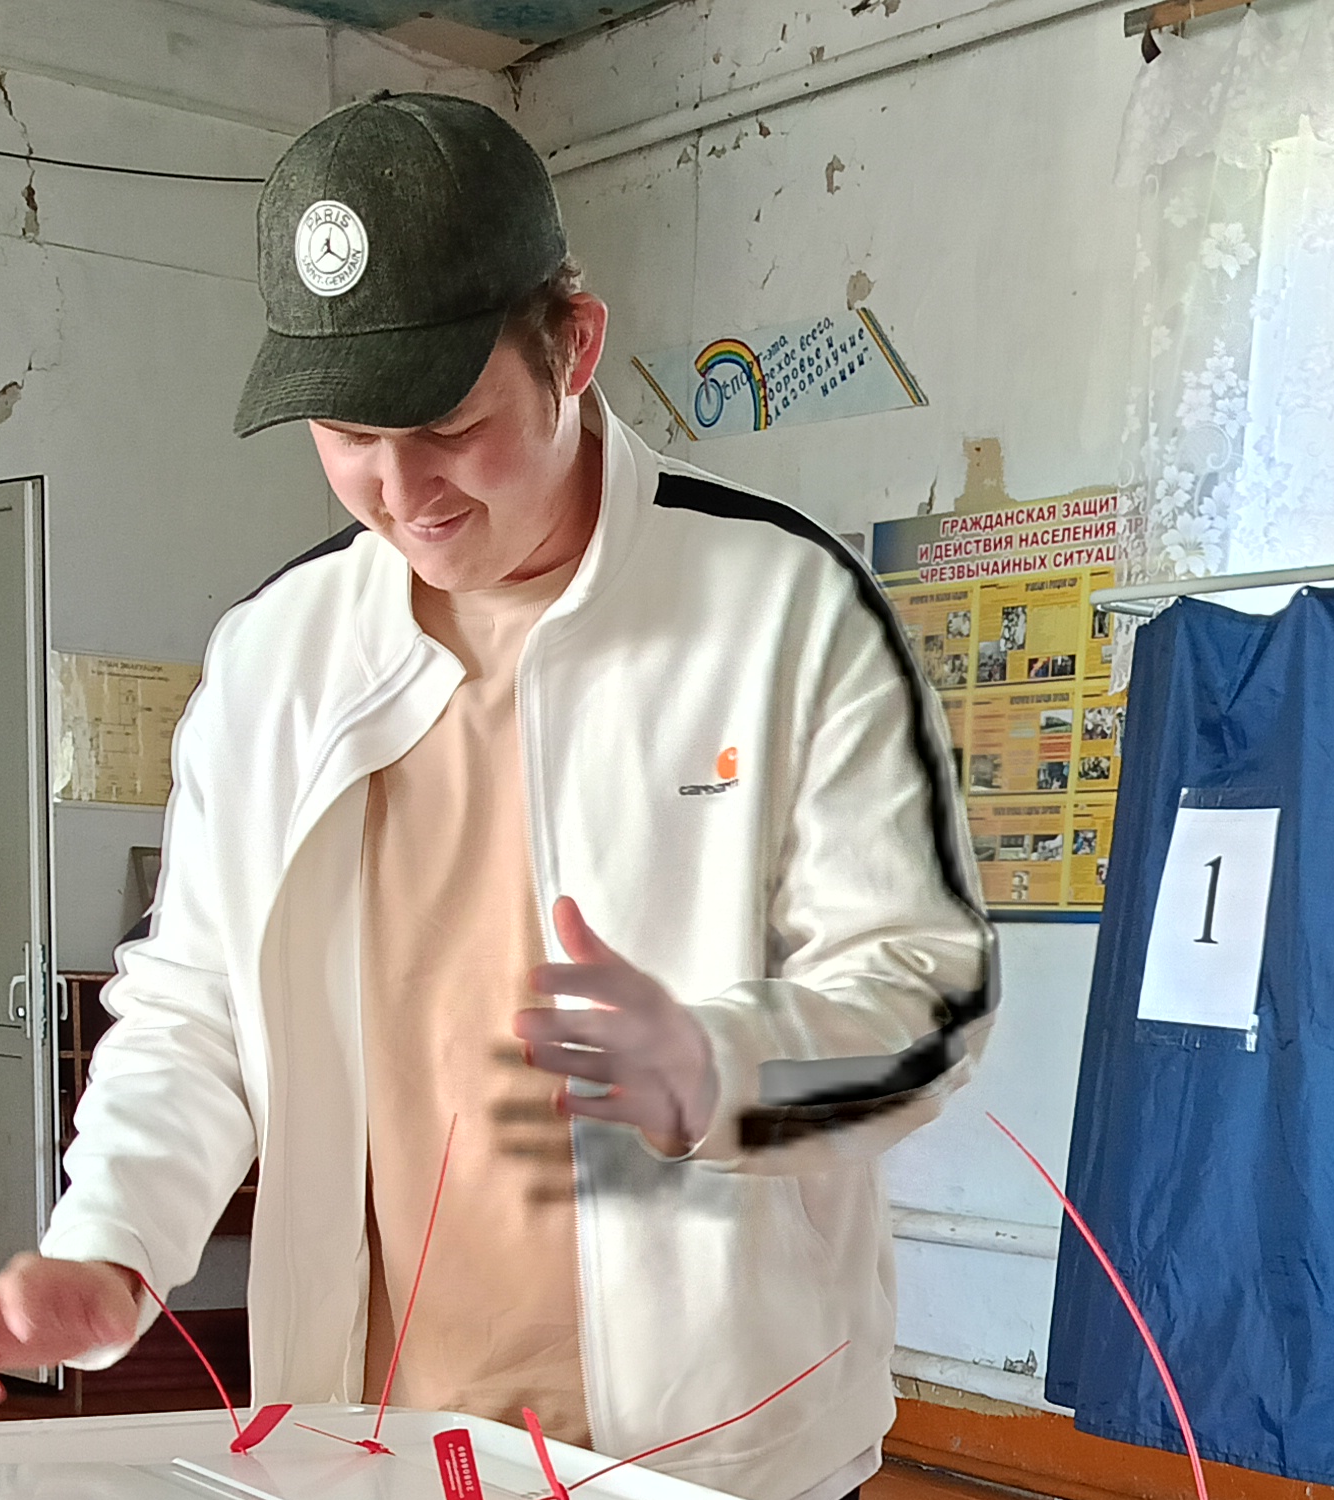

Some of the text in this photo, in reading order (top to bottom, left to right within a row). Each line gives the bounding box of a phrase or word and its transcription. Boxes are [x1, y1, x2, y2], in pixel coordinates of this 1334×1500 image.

[306, 208, 351, 231] PARIS
[941, 495, 1119, 537] ГРАЖДАНСКАЯ ЗАЩИТ
[919, 545, 930, 563] И
[933, 534, 1014, 563] ДЕЙСТВИЯ
[1019, 520, 1117, 550] НАСЕЛЕНИЯ
[919, 554, 1048, 584] ЧРЕЗВЫЧАЙНЫХ
[1193, 855, 1220, 945] 1
